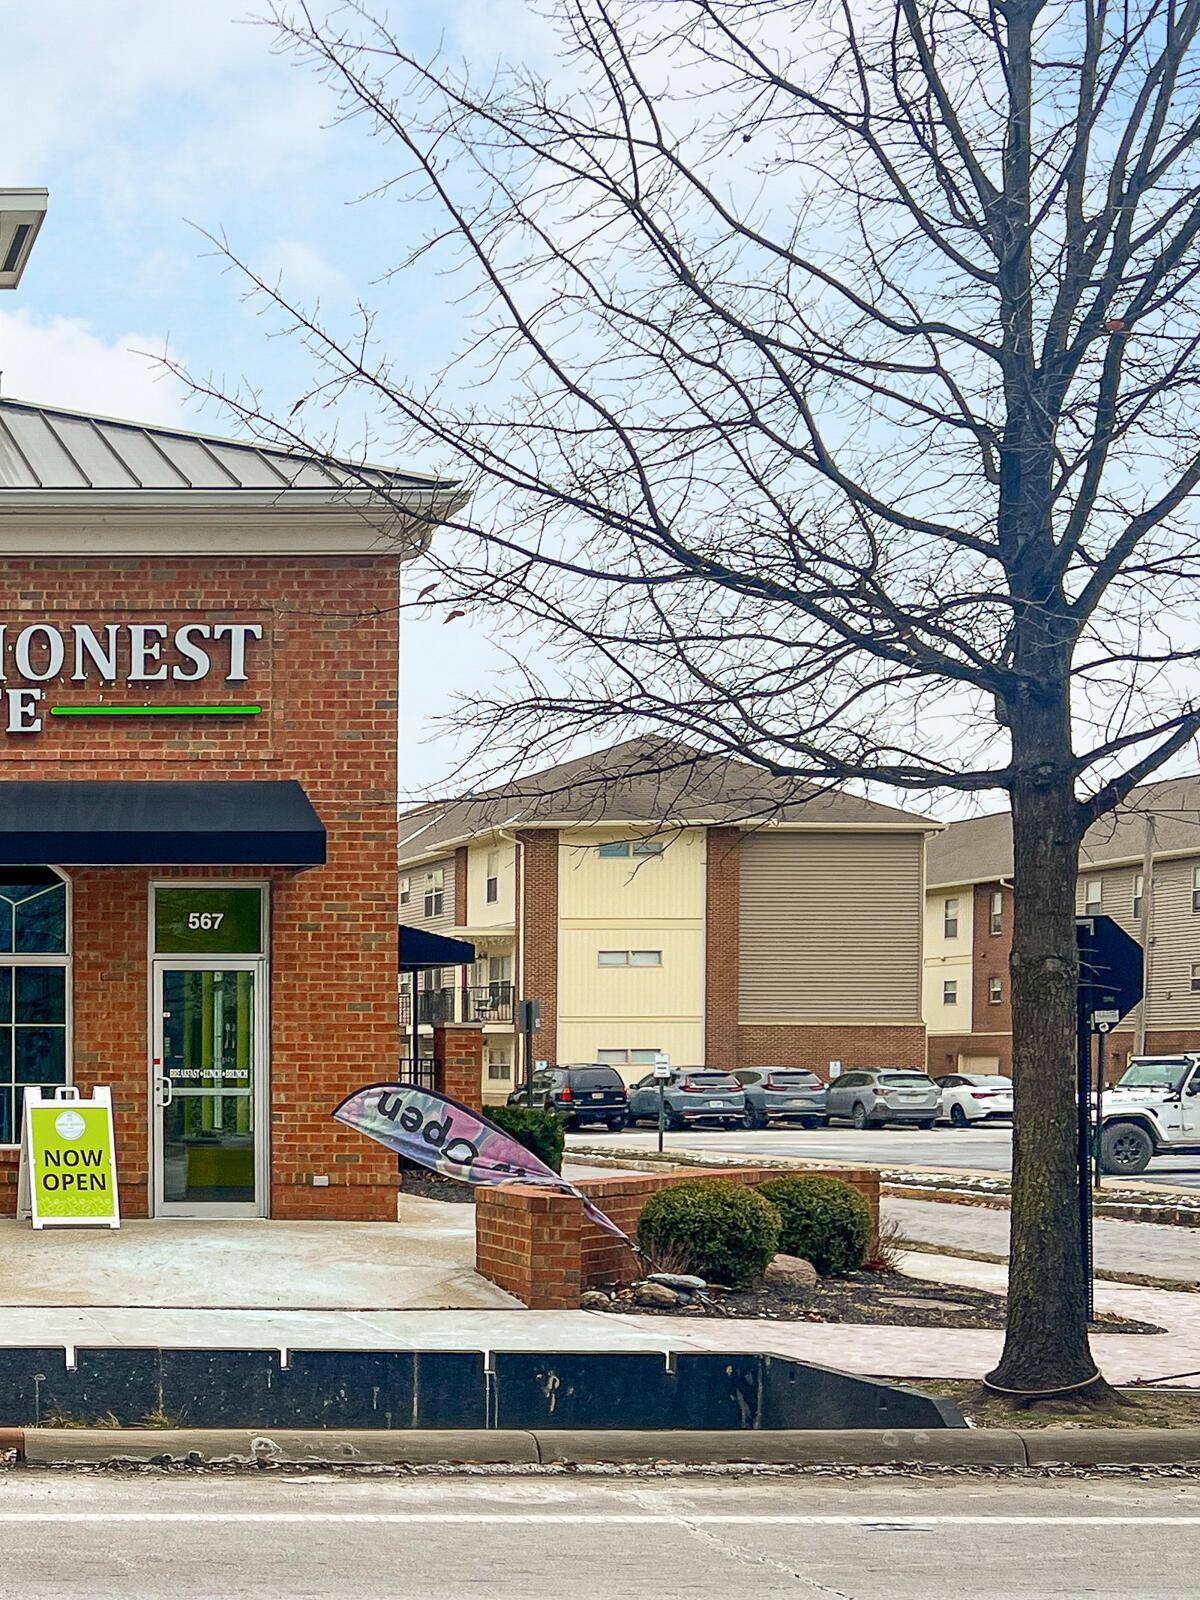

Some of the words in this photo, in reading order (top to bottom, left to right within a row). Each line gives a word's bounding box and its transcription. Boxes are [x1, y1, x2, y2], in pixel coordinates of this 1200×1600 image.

[188, 912, 224, 930] 567
[377, 1090, 479, 1166] Open
[44, 1149, 103, 1167] NOW
[42, 1173, 106, 1191] OPEN
